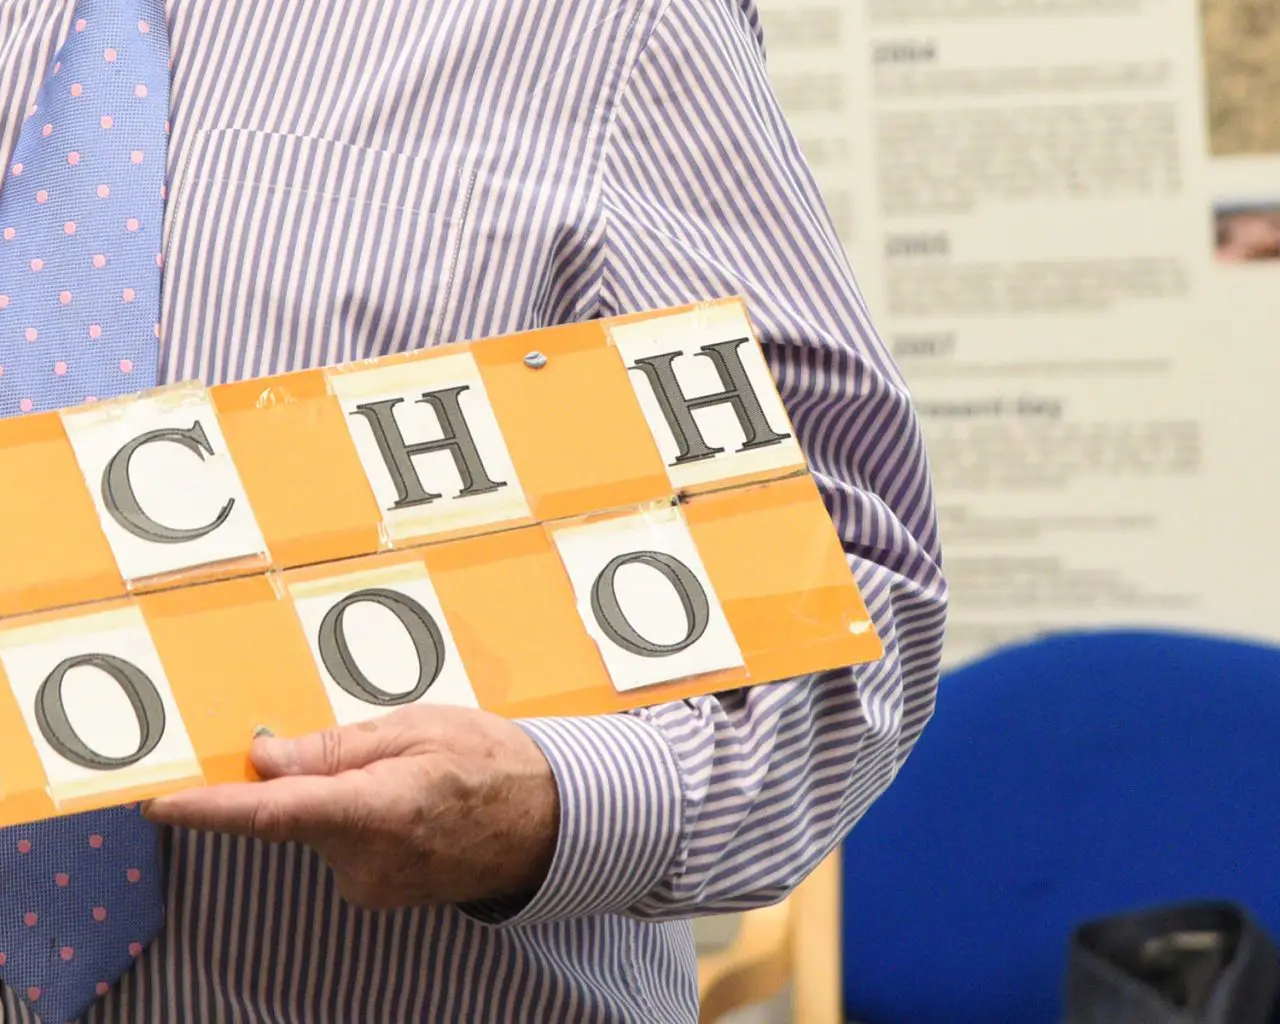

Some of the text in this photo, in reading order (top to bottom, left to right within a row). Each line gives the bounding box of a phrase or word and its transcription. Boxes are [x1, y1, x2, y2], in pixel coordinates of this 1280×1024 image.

[100, 419, 236, 545] C
[349, 384, 508, 511] H
[628, 336, 792, 467] H
[917, 396, 1003, 418] resent
[33, 652, 166, 772] O
[317, 587, 446, 706] O
[590, 549, 710, 658] O
